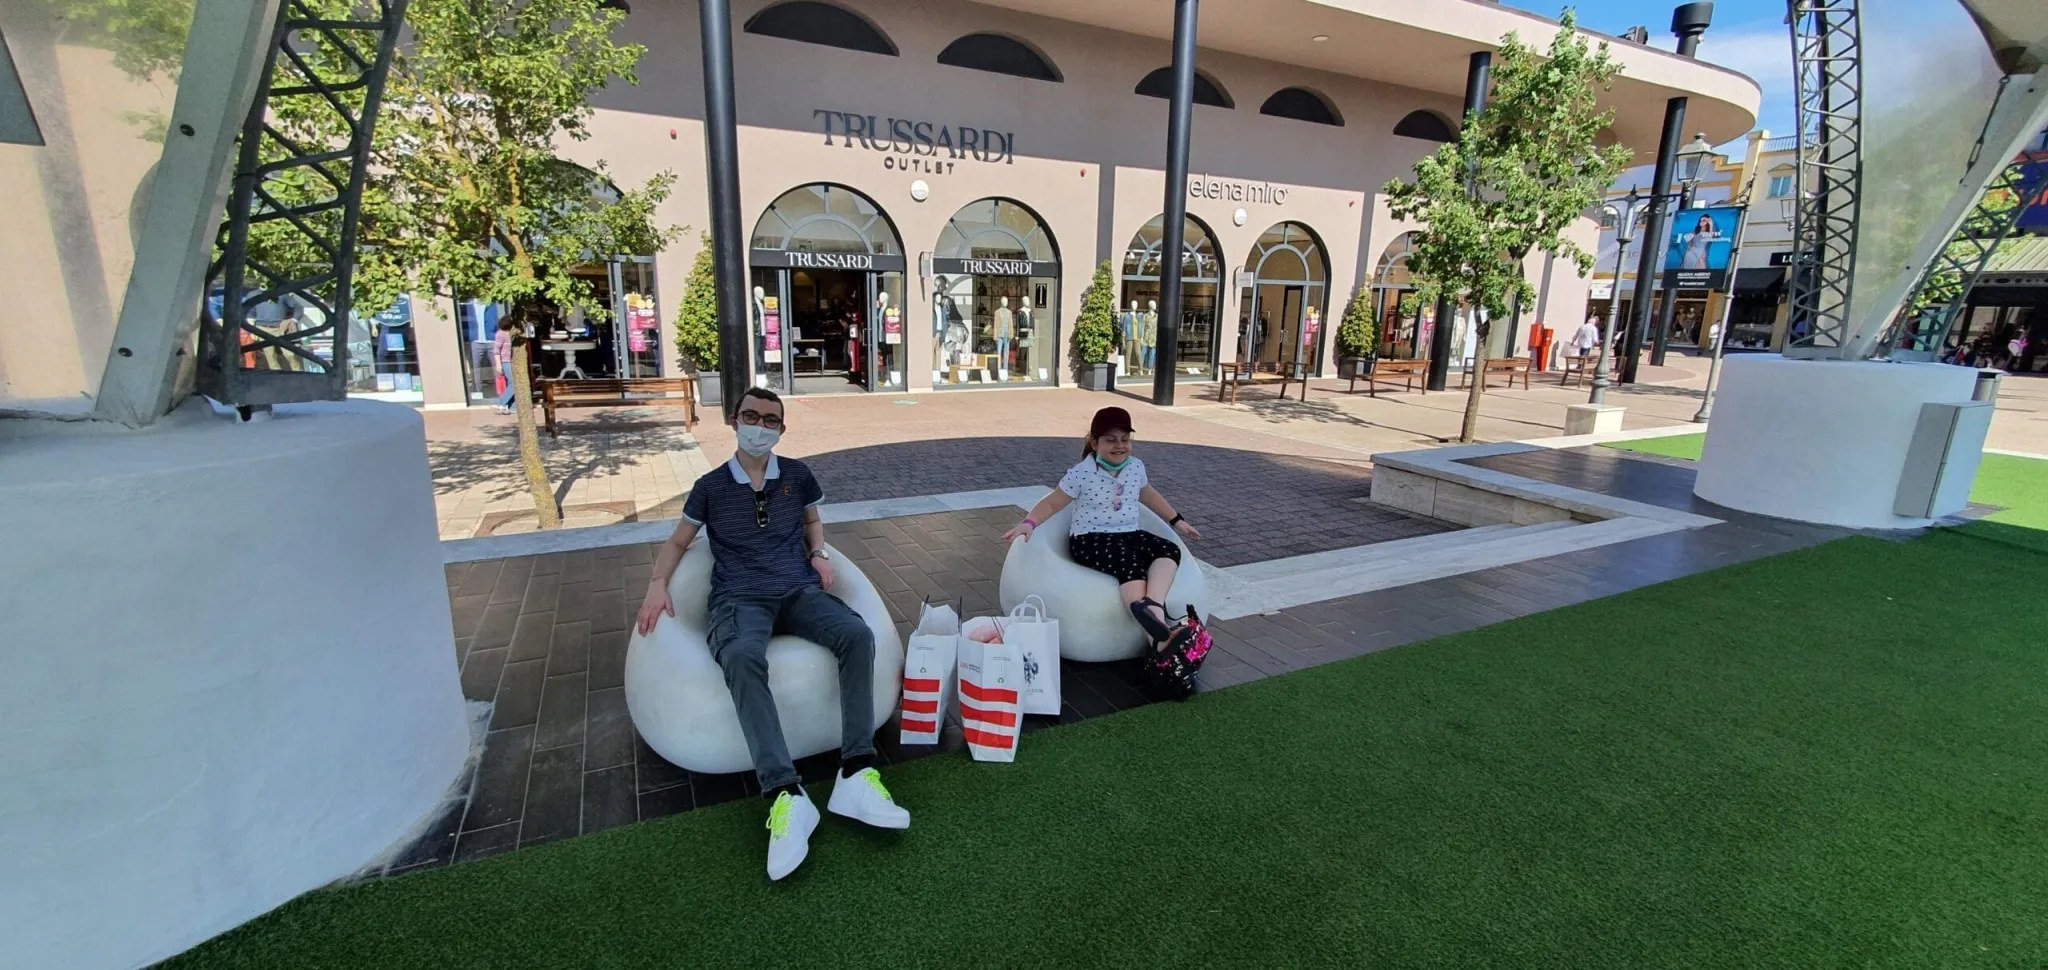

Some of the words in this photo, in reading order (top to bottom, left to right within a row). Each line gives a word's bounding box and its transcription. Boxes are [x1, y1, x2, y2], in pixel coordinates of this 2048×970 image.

[813, 109, 1015, 165] TRUSSARDI
[884, 156, 955, 175] OUTLET
[1190, 173, 1242, 202] elena
[785, 252, 873, 269] TRUSSARDI
[960, 259, 1032, 275] TRUSSARDI
